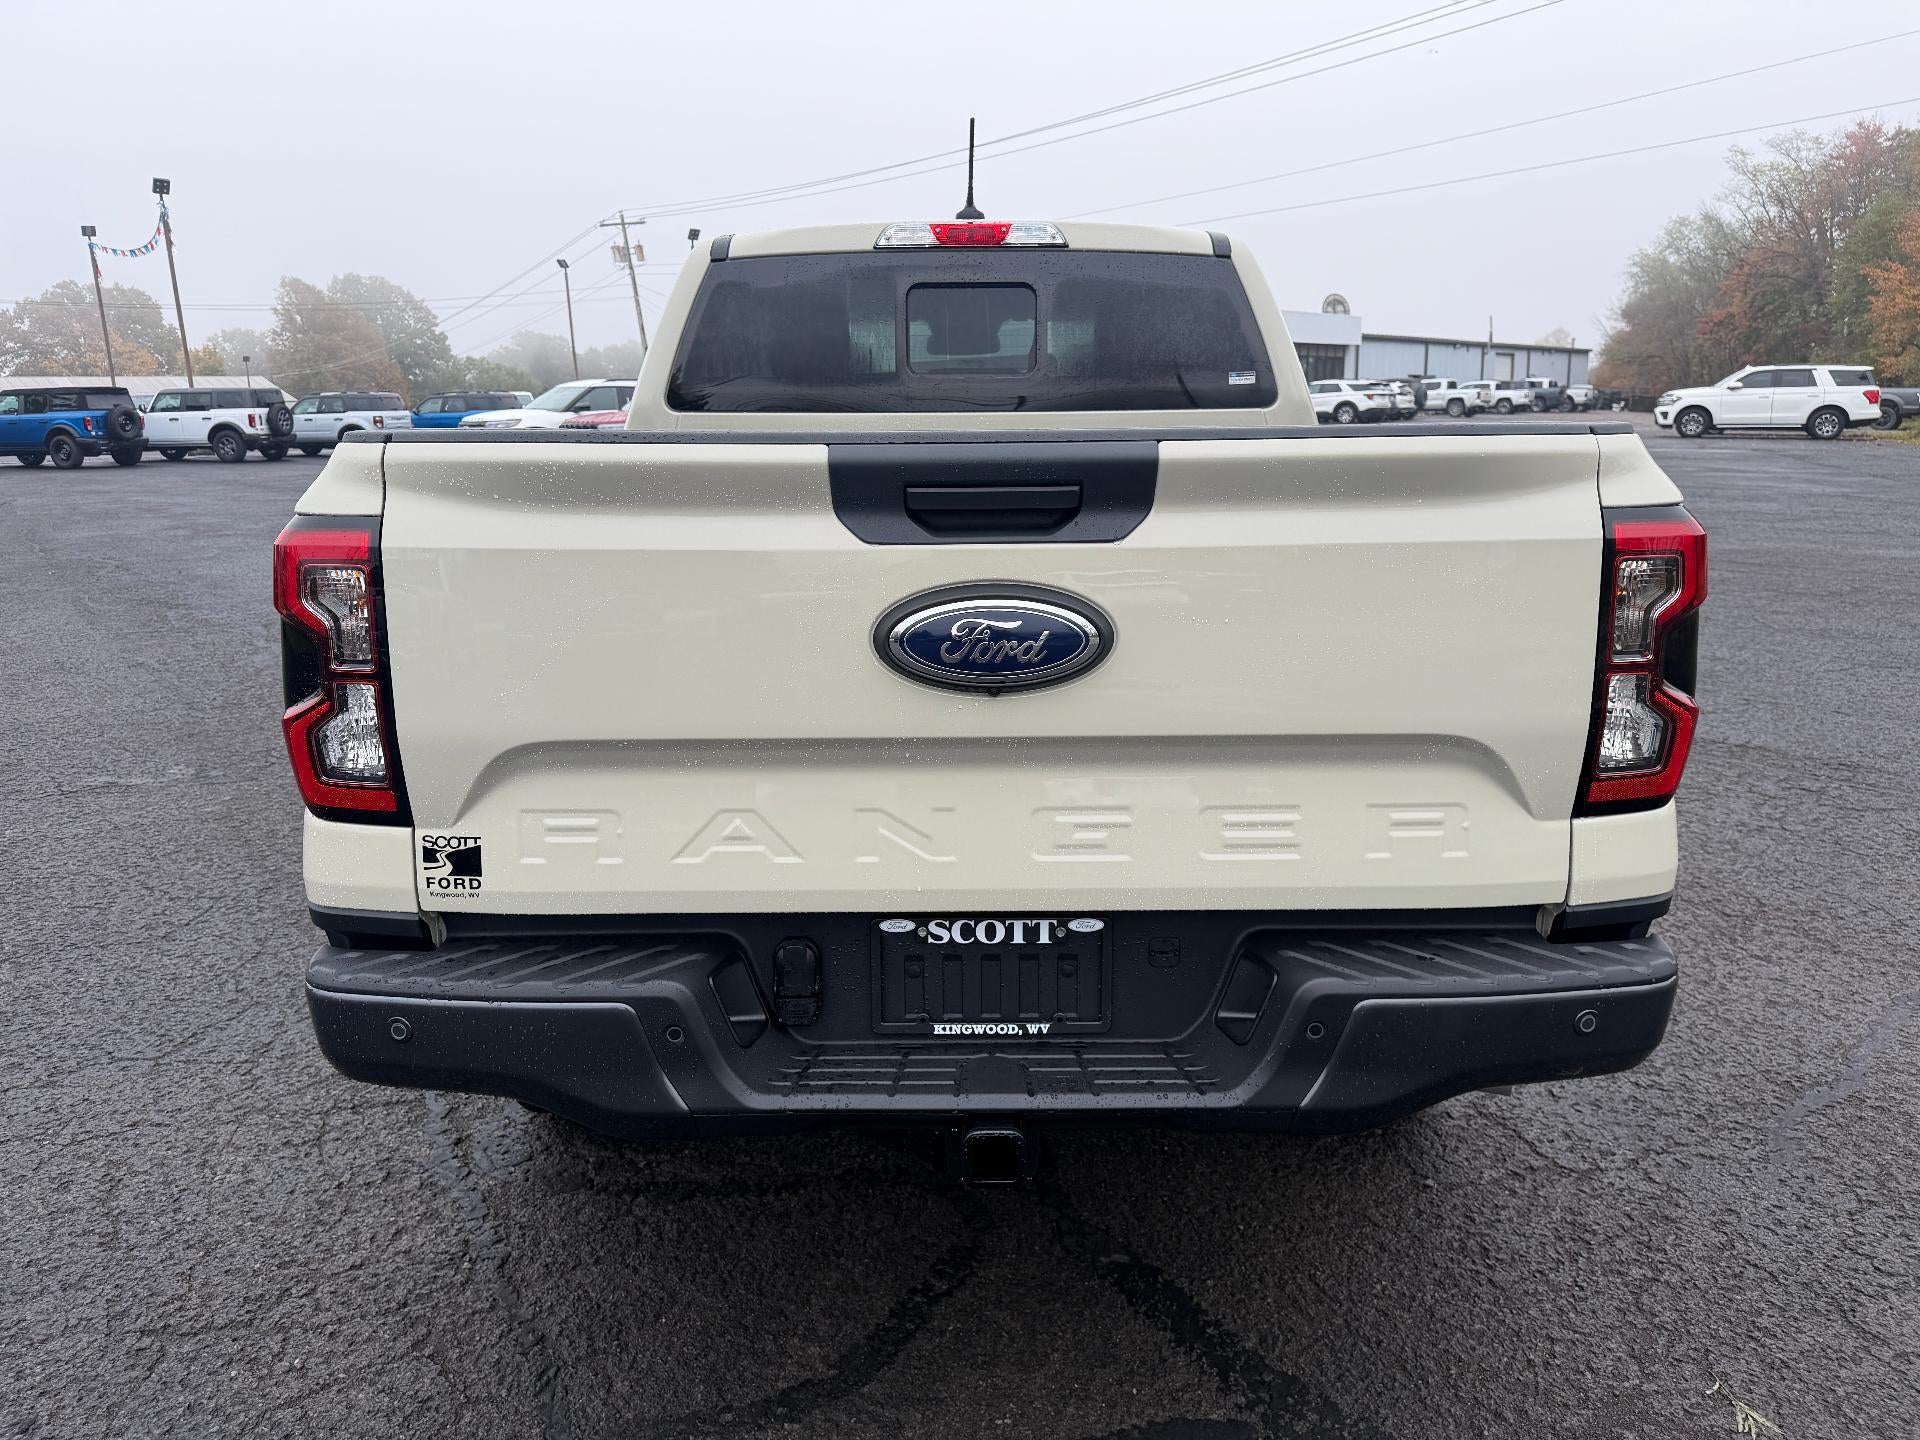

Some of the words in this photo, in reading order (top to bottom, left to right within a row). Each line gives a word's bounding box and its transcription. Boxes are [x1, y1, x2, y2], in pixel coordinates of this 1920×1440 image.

[940, 618, 1050, 664] Ford
[422, 835, 482, 849] SCOTT
[518, 802, 1470, 865] RANGER
[426, 877, 482, 890] FORD
[927, 919, 1058, 944] SCOTT
[933, 1024, 1023, 1036] KINGWOOD,
[1026, 1023, 1051, 1035] WV
